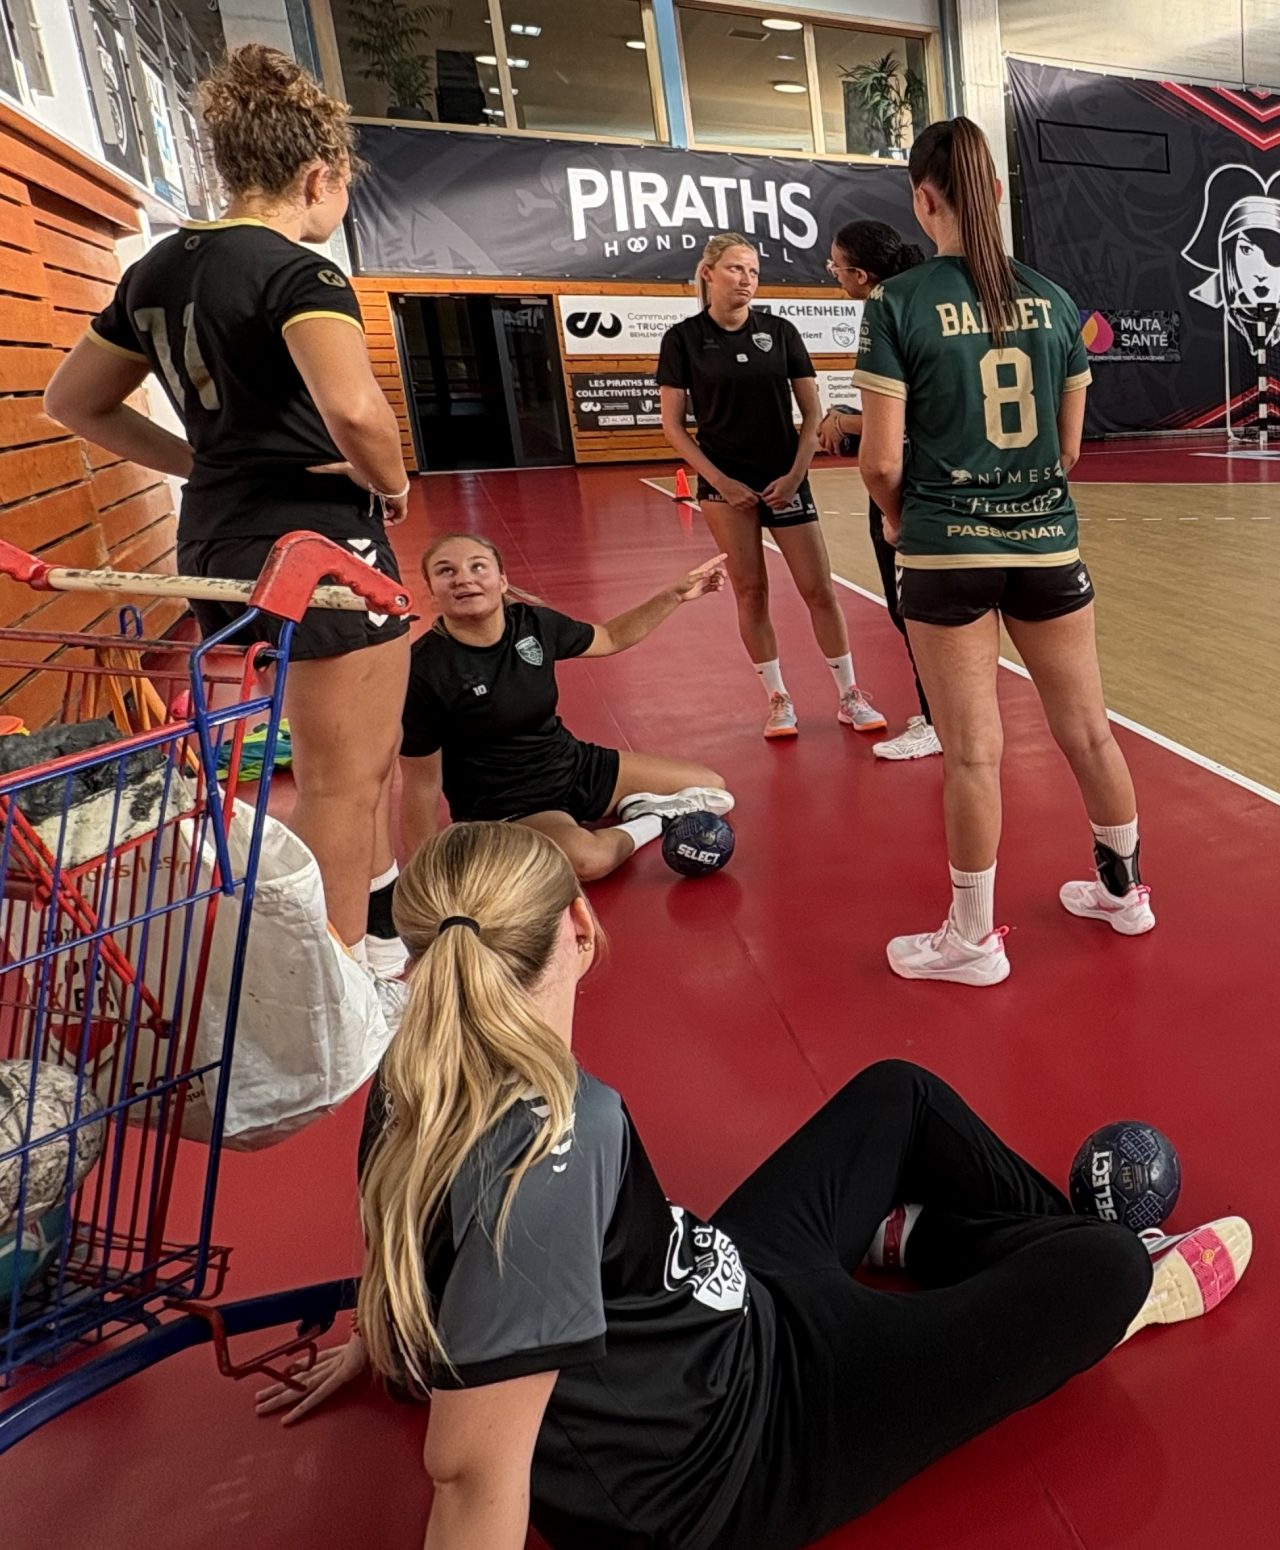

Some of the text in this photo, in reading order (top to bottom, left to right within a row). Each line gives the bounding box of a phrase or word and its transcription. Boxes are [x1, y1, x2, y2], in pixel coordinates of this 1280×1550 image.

[566, 167, 819, 250] PIRATHS
[604, 234, 794, 263] HANDLL
[627, 312, 677, 320] Commune
[779, 306, 856, 316] ACHENHEIM
[1120, 318, 1161, 331] MUTA
[800, 331, 823, 339] tient
[1121, 331, 1168, 347] SANTÉ
[589, 380, 604, 388] LES
[606, 379, 642, 387] PIRATHS
[576, 388, 641, 398] COLLECTIVITÉS
[979, 347, 1039, 450] 8
[978, 467, 1051, 485] NÎMES
[946, 525, 1067, 541] PASSIONATA
[472, 684, 488, 696] 10
[676, 843, 721, 866] SELECT
[1091, 1150, 1119, 1222] SELECT
[691, 1224, 714, 1248] et
